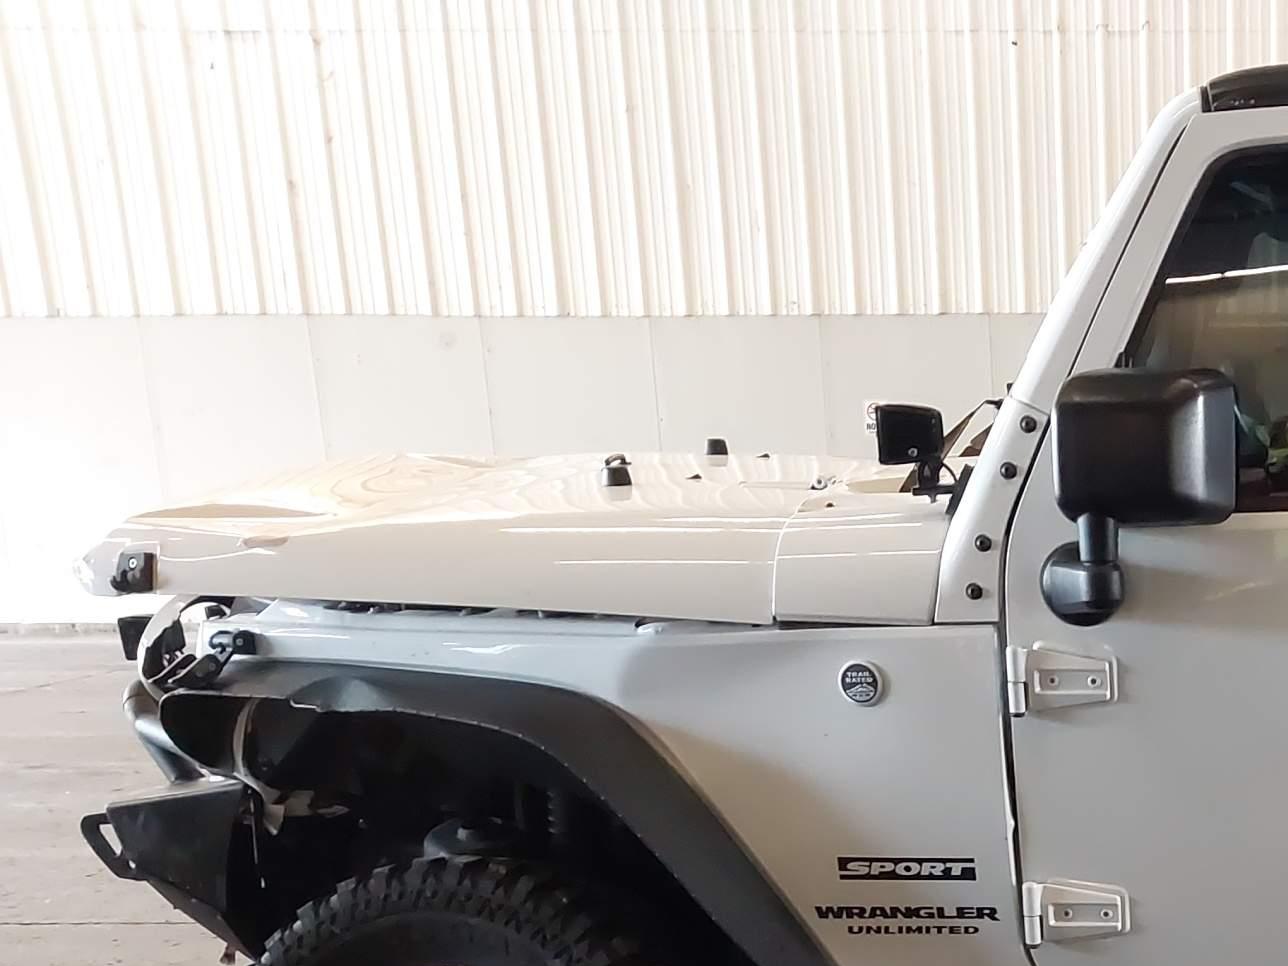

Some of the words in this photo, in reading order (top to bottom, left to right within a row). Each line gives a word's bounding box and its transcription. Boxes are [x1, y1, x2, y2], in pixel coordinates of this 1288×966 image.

[843, 860, 975, 878] SPORT
[815, 906, 1000, 921] WRANGLER
[848, 925, 979, 935] UNLIMITED
